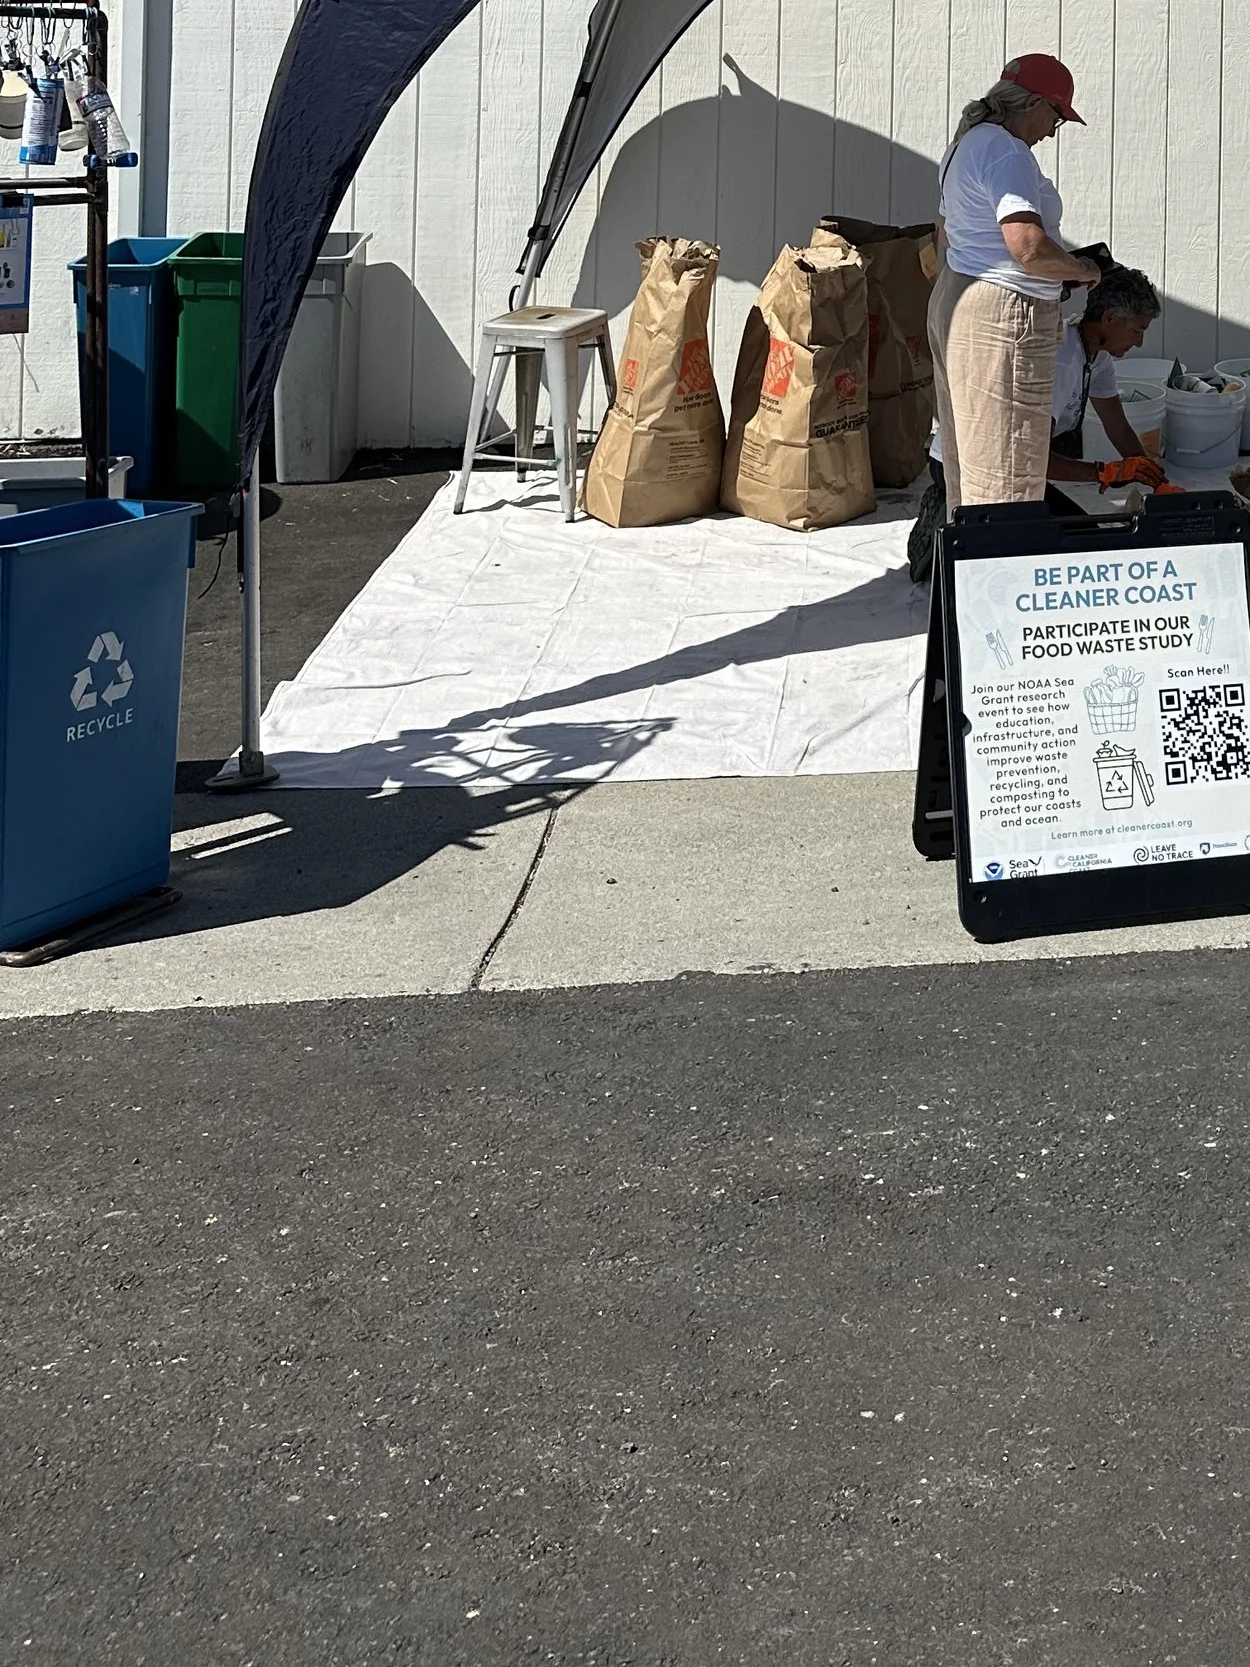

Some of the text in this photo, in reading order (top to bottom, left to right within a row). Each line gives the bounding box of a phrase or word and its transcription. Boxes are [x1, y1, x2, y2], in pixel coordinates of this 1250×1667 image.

[1034, 560, 1178, 586] BE PART OF A
[1016, 583, 1197, 612] CLEANER COAST
[1023, 616, 1190, 641] PARTICIPATE IN OUR
[1022, 633, 1194, 660] FOOD WASTE STUDY
[1168, 664, 1230, 678] Scan Here!!
[971, 678, 1074, 694] Join our NOAA Sea
[981, 689, 1065, 705] Grant research
[978, 706, 1009, 718] event
[1012, 706, 1023, 714] to
[1048, 703, 1070, 712] how
[67, 708, 133, 742] RECYCLE
[996, 716, 1054, 728] education,
[973, 724, 1078, 742] infrastructure, and
[977, 738, 1076, 755] community action
[987, 751, 1068, 767] improve waste
[996, 765, 1060, 780] prevention,
[990, 774, 1068, 791] recycling, and
[990, 788, 1069, 803] composting to
[980, 799, 1081, 819] protect our coasts
[1001, 816, 1022, 827] and
[1051, 819, 1193, 839] Learn more at cleanercoast.org
[1151, 844, 1176, 853] LEAVE
[1167, 851, 1194, 860] TRACE
[1009, 859, 1028, 869] Sea
[1073, 858, 1112, 867] CALIFORNIA
[1010, 869, 1038, 879] Grant
